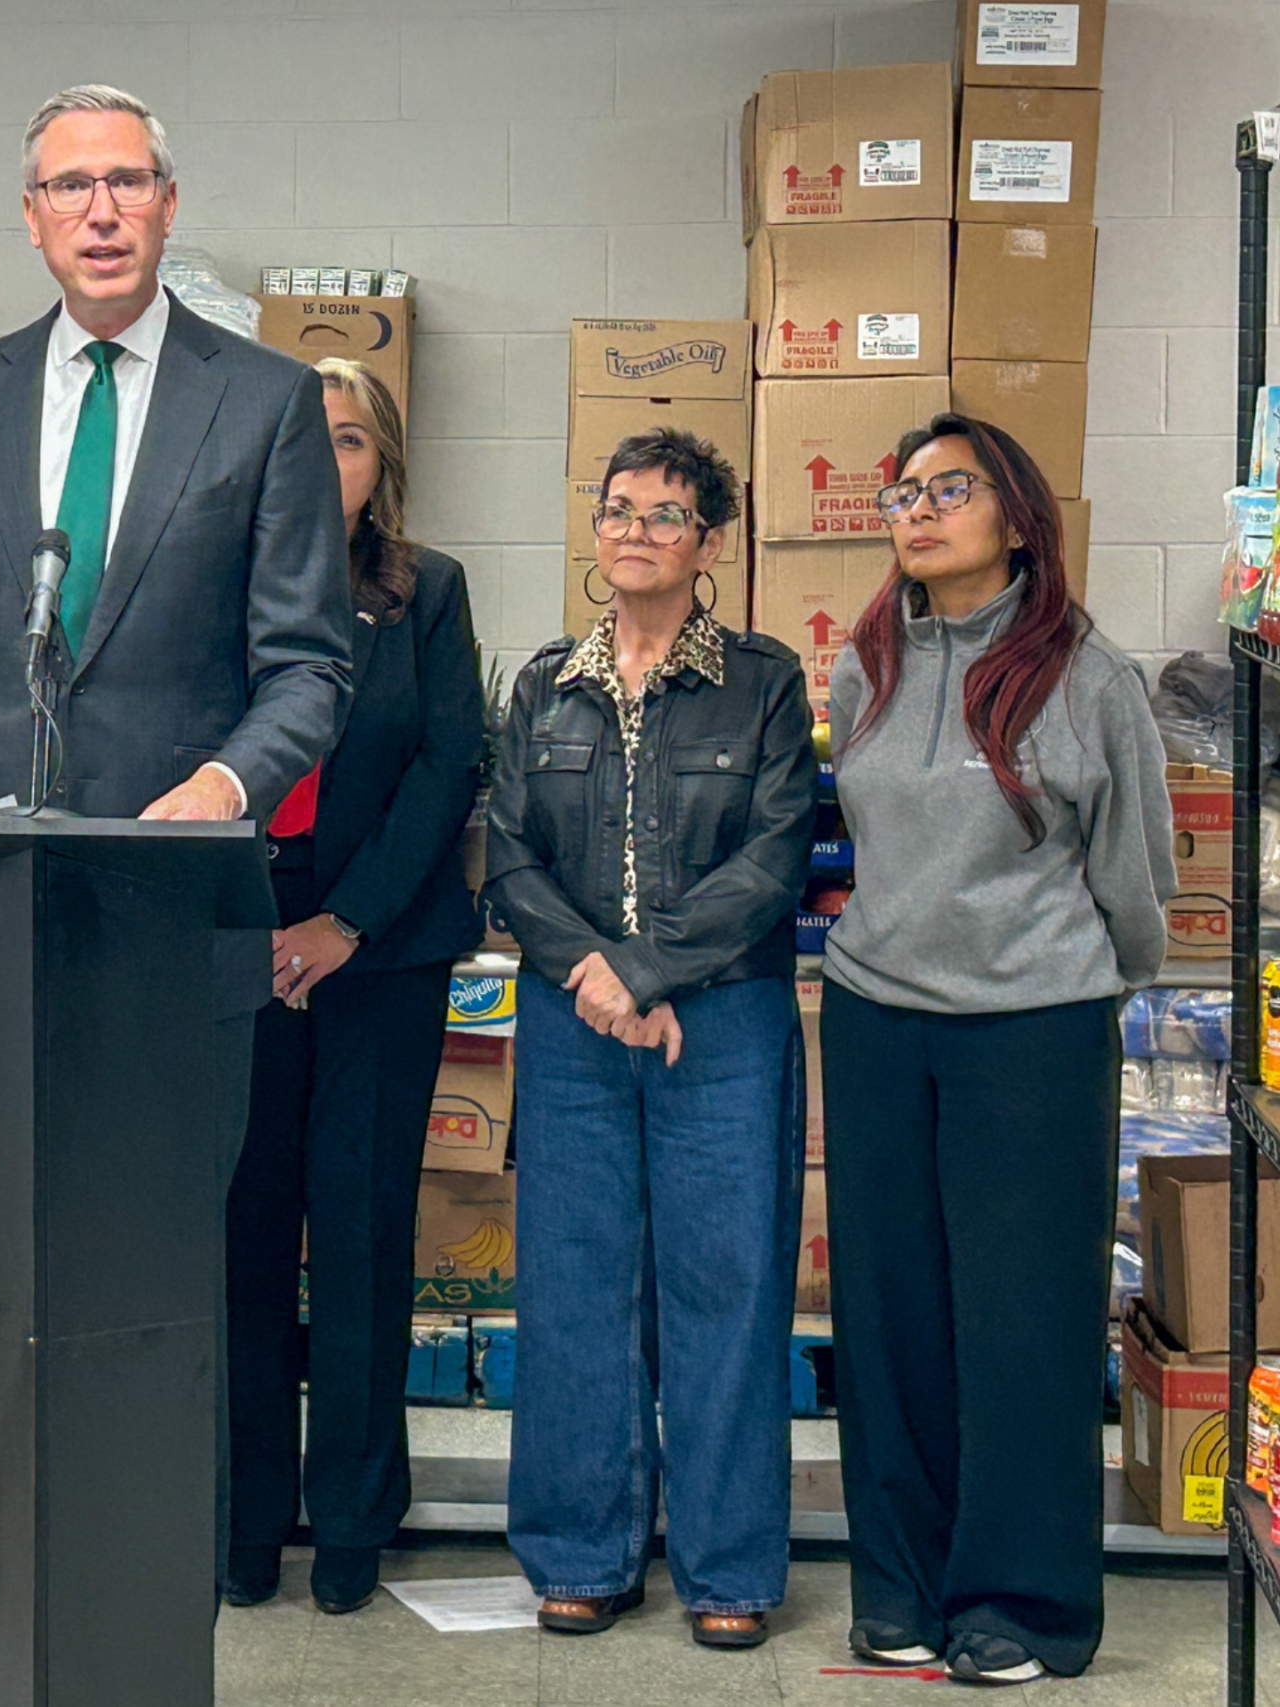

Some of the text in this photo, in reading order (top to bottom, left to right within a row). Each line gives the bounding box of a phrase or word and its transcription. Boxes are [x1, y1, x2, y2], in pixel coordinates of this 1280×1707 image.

[790, 192, 836, 201] FRAGILE
[786, 346, 834, 355] FRAGILE
[614, 348, 684, 378] Vegetable
[1171, 914, 1226, 936] Dole
[450, 977, 504, 1008] Chiquita
